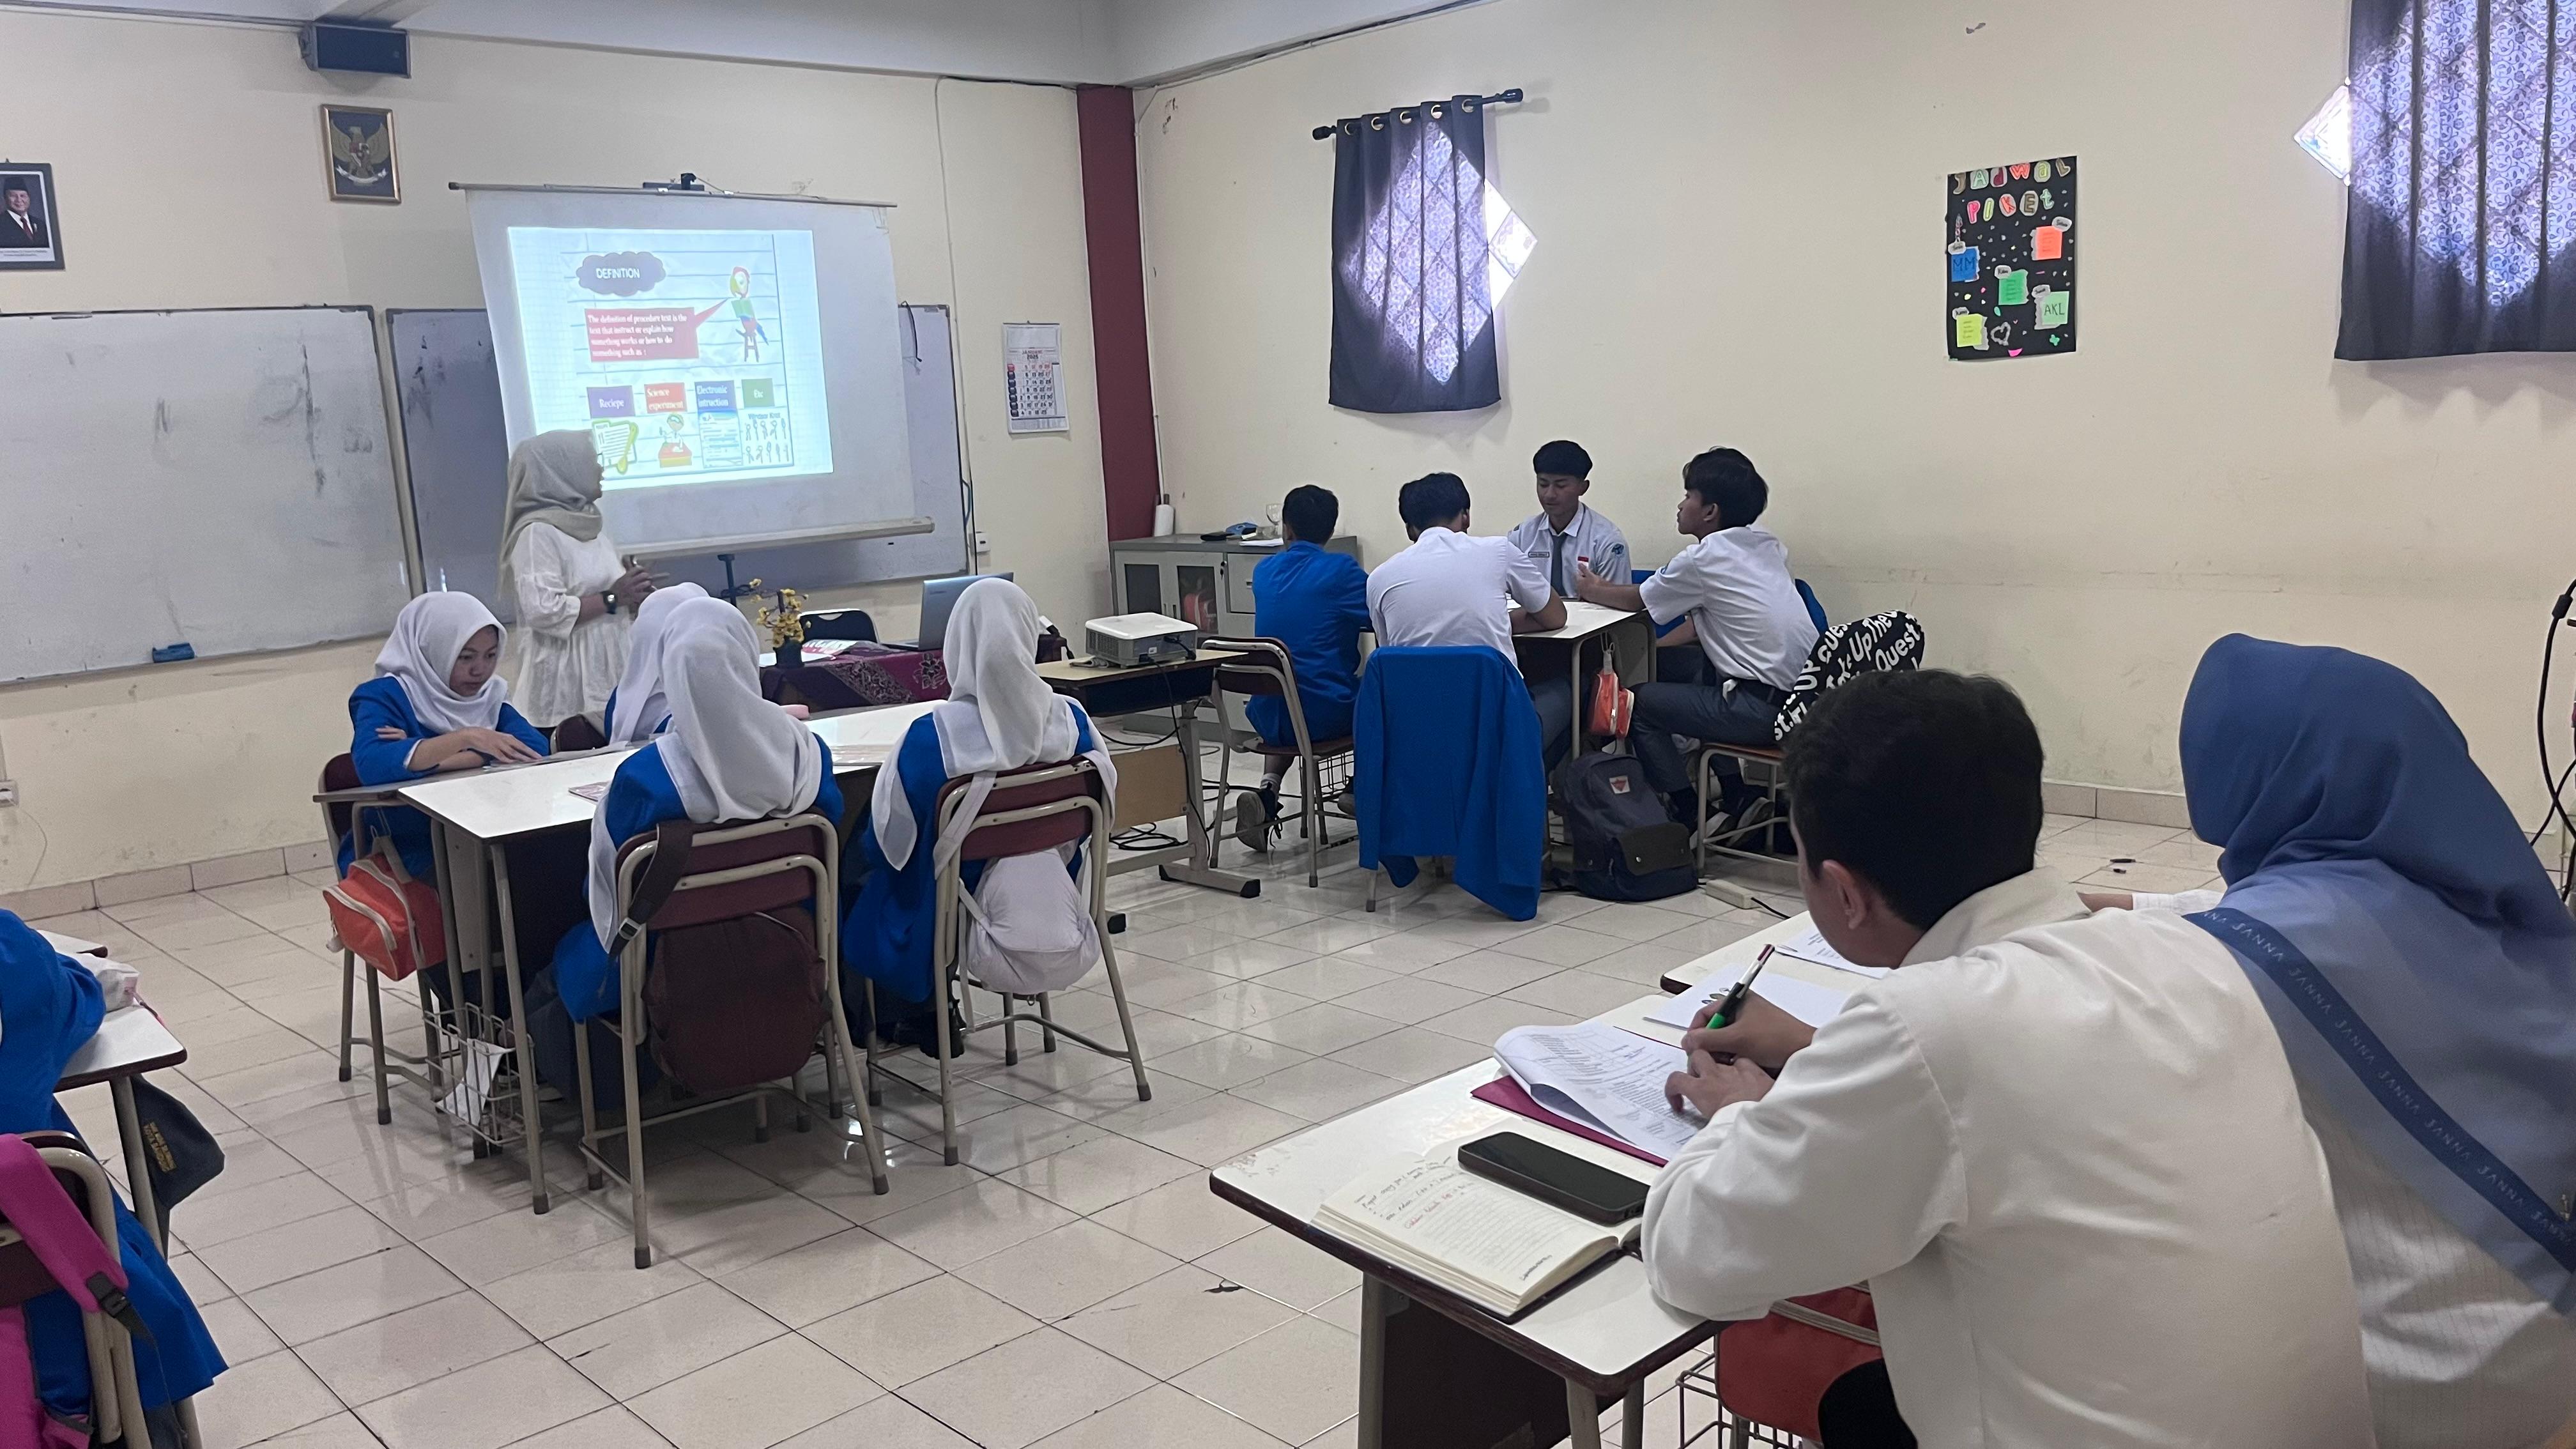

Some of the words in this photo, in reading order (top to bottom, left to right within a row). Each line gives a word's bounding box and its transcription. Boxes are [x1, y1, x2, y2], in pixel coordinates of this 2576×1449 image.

[596, 268, 640, 279] DEFINITION
[2044, 302, 2065, 316] AKL
[588, 314, 599, 323] The
[600, 314, 626, 323] definition
[627, 314, 632, 323] of
[634, 314, 660, 325] procedure
[678, 313, 687, 322] the
[661, 324, 674, 332] how
[664, 335, 673, 344] do
[696, 385, 728, 395] Electronic
[753, 389, 763, 399] Etc
[648, 401, 684, 411] experiment
[1875, 622, 1920, 671] Quest
[2232, 923, 2285, 962] JANNA
[2288, 967, 2331, 1015] JANNA
[2334, 1020, 2375, 1065] JANNA
[2377, 1071, 2420, 1115] JANNA
[2424, 1119, 2471, 1160] JANNA
[2477, 1165, 2524, 1206] JANNA
